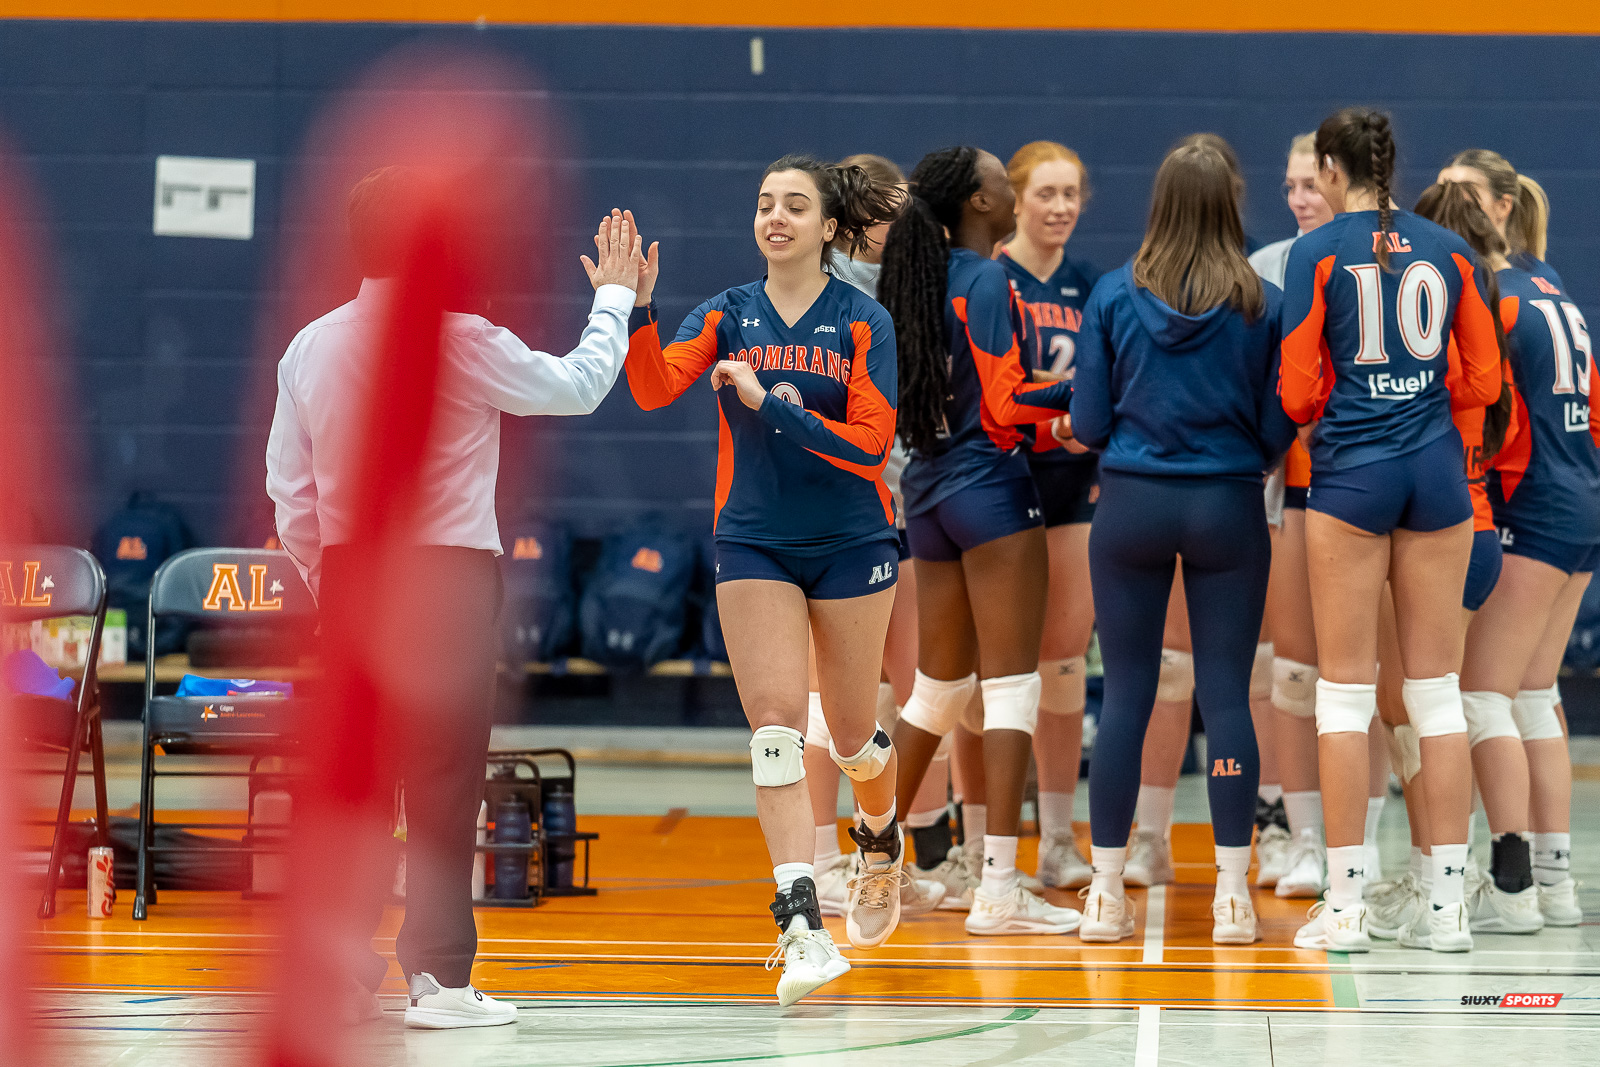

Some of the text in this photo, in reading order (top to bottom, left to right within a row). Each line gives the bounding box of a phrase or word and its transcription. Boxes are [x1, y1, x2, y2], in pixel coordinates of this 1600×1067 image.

[1343, 260, 1448, 365] 10
[728, 344, 852, 387] OOMERANG
[1529, 299, 1592, 396] 15
[203, 563, 283, 611] AL
[868, 561, 892, 585] AL
[1211, 758, 1242, 777] AL
